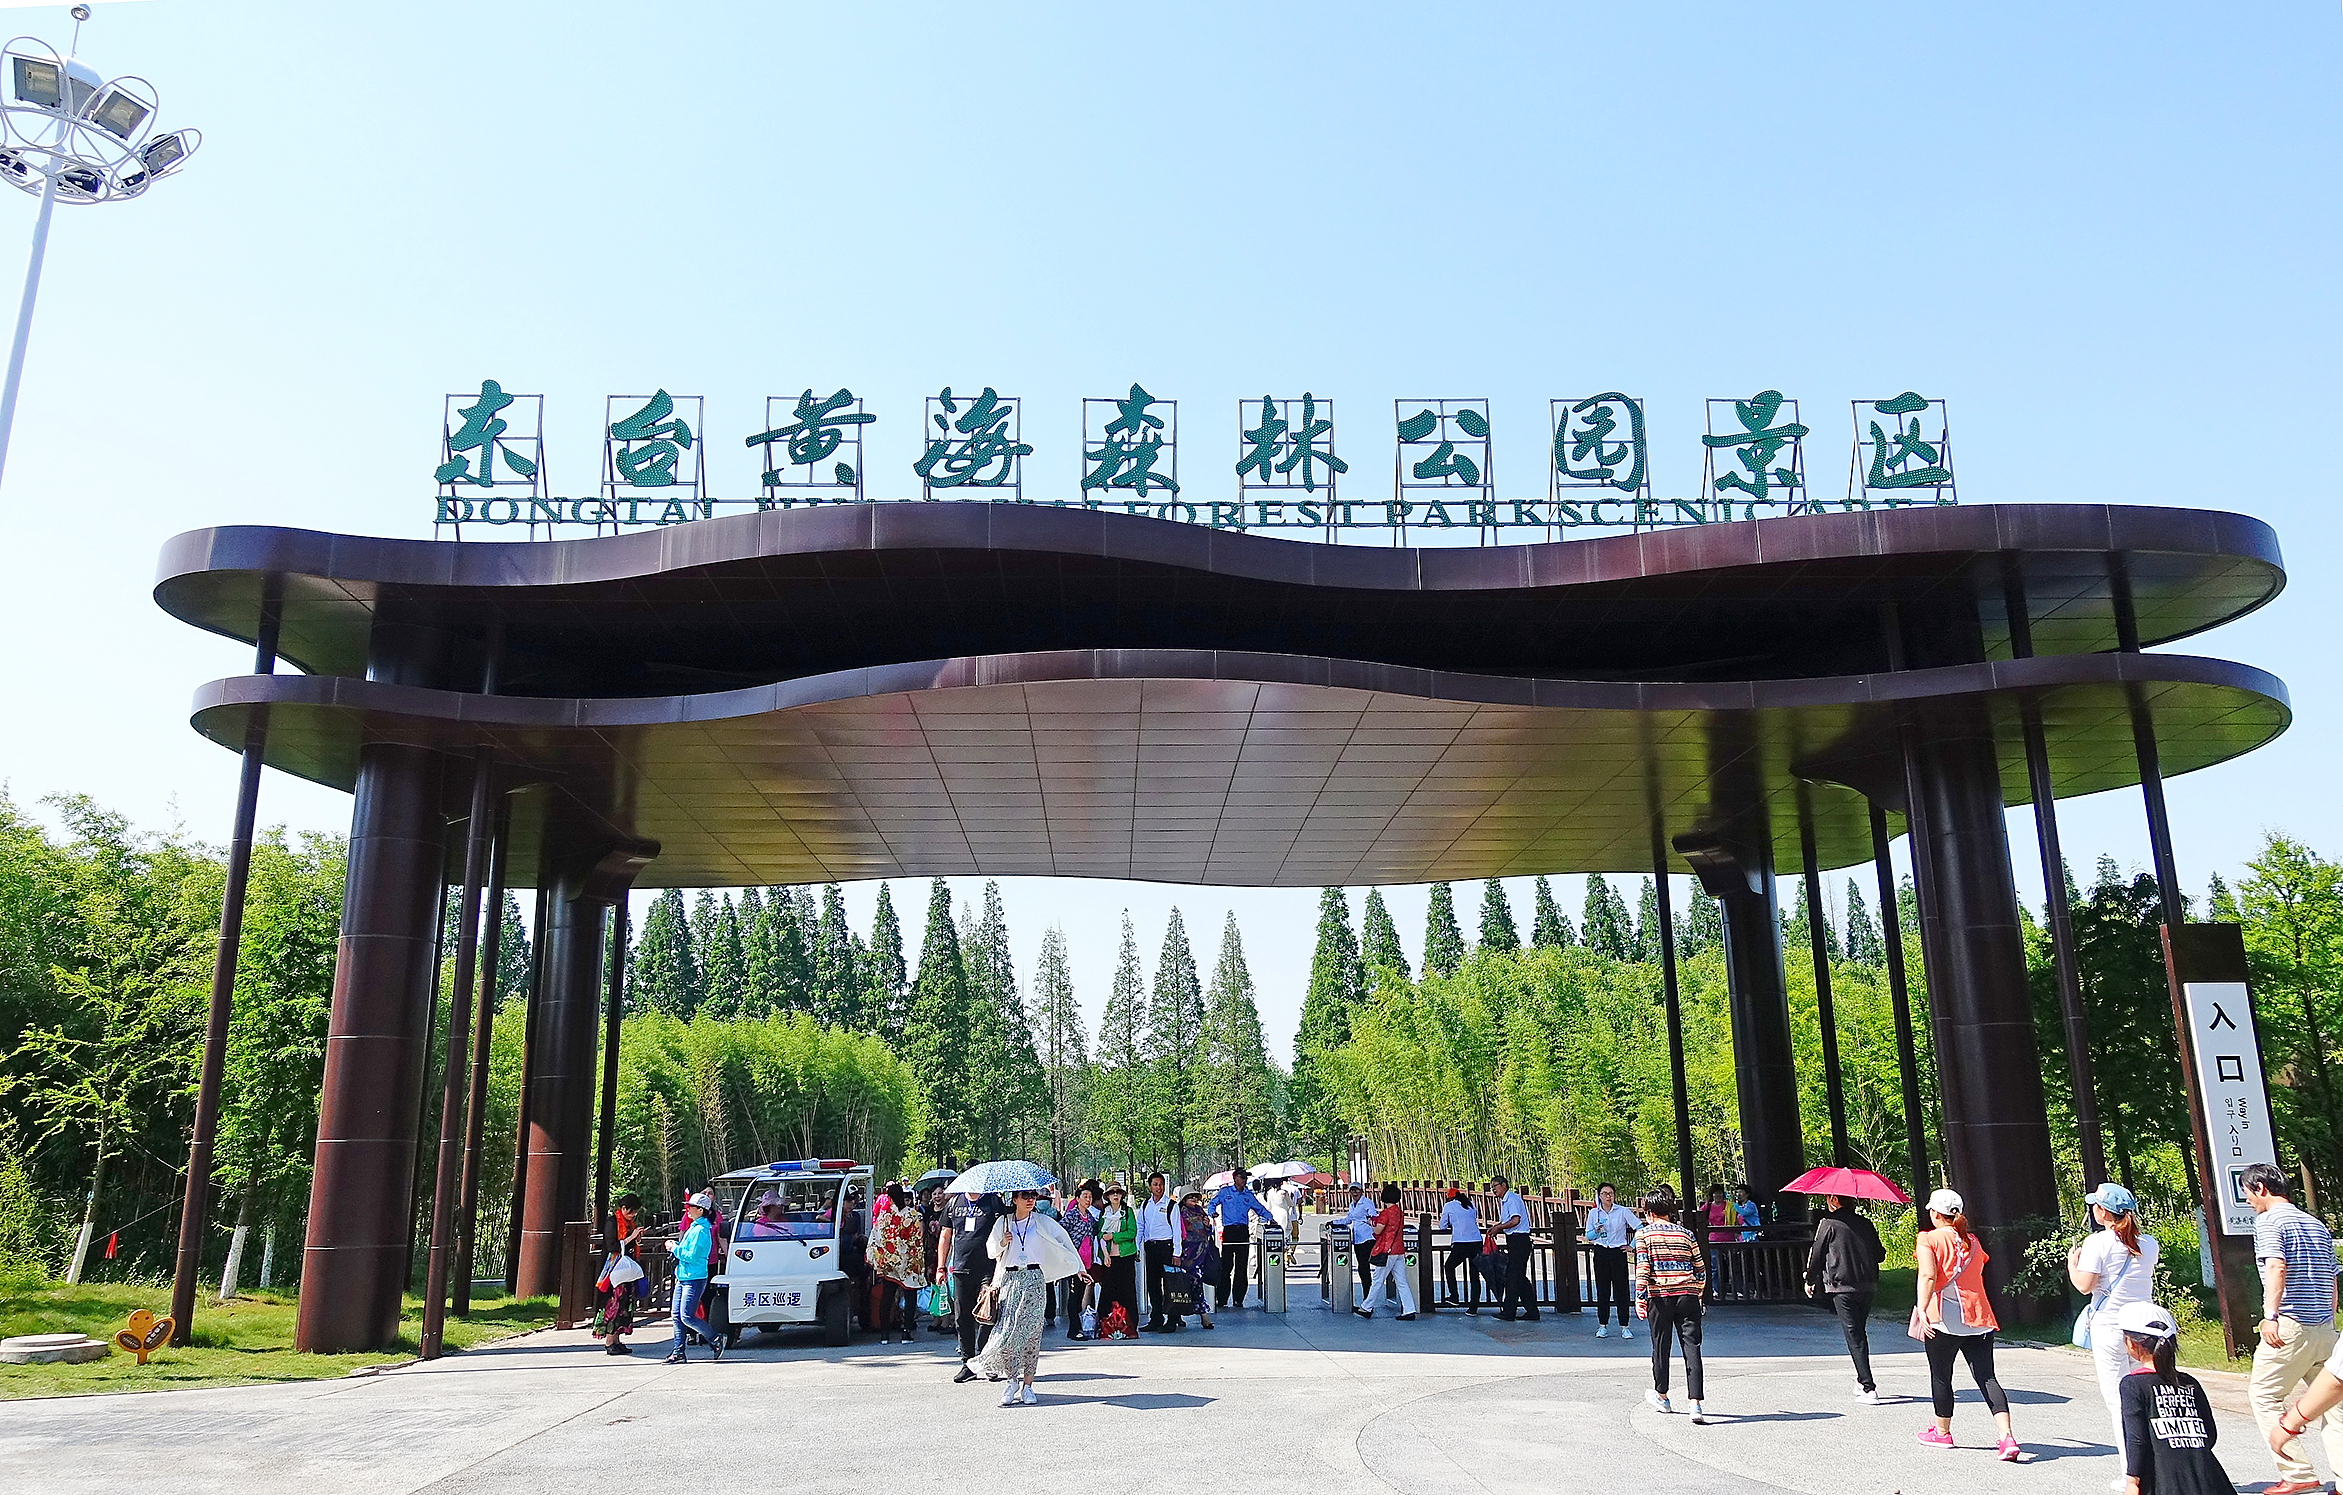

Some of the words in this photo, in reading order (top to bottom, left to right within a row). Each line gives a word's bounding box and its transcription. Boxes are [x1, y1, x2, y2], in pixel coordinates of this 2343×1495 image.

[433, 379, 1953, 499] 东台黄海森林公园景区
[435, 496, 718, 525] DONGTAI
[1381, 499, 1548, 527] PARK
[1557, 498, 1776, 526] SCENIC
[2208, 1001, 2245, 1082] 入口
[2238, 1097, 2248, 1119] Way
[2241, 1120, 2251, 1130] in
[2229, 1124, 2243, 1157] 入り口
[742, 1292, 802, 1307] 景区巡逻
[2152, 1385, 2159, 1396] I
[2160, 1384, 2176, 1396] AM
[2155, 1395, 2196, 1408] PERFECT
[2158, 1407, 2177, 1418] BUT
[2178, 1407, 2183, 1417] I
[2167, 1437, 2206, 1449] EDITION
